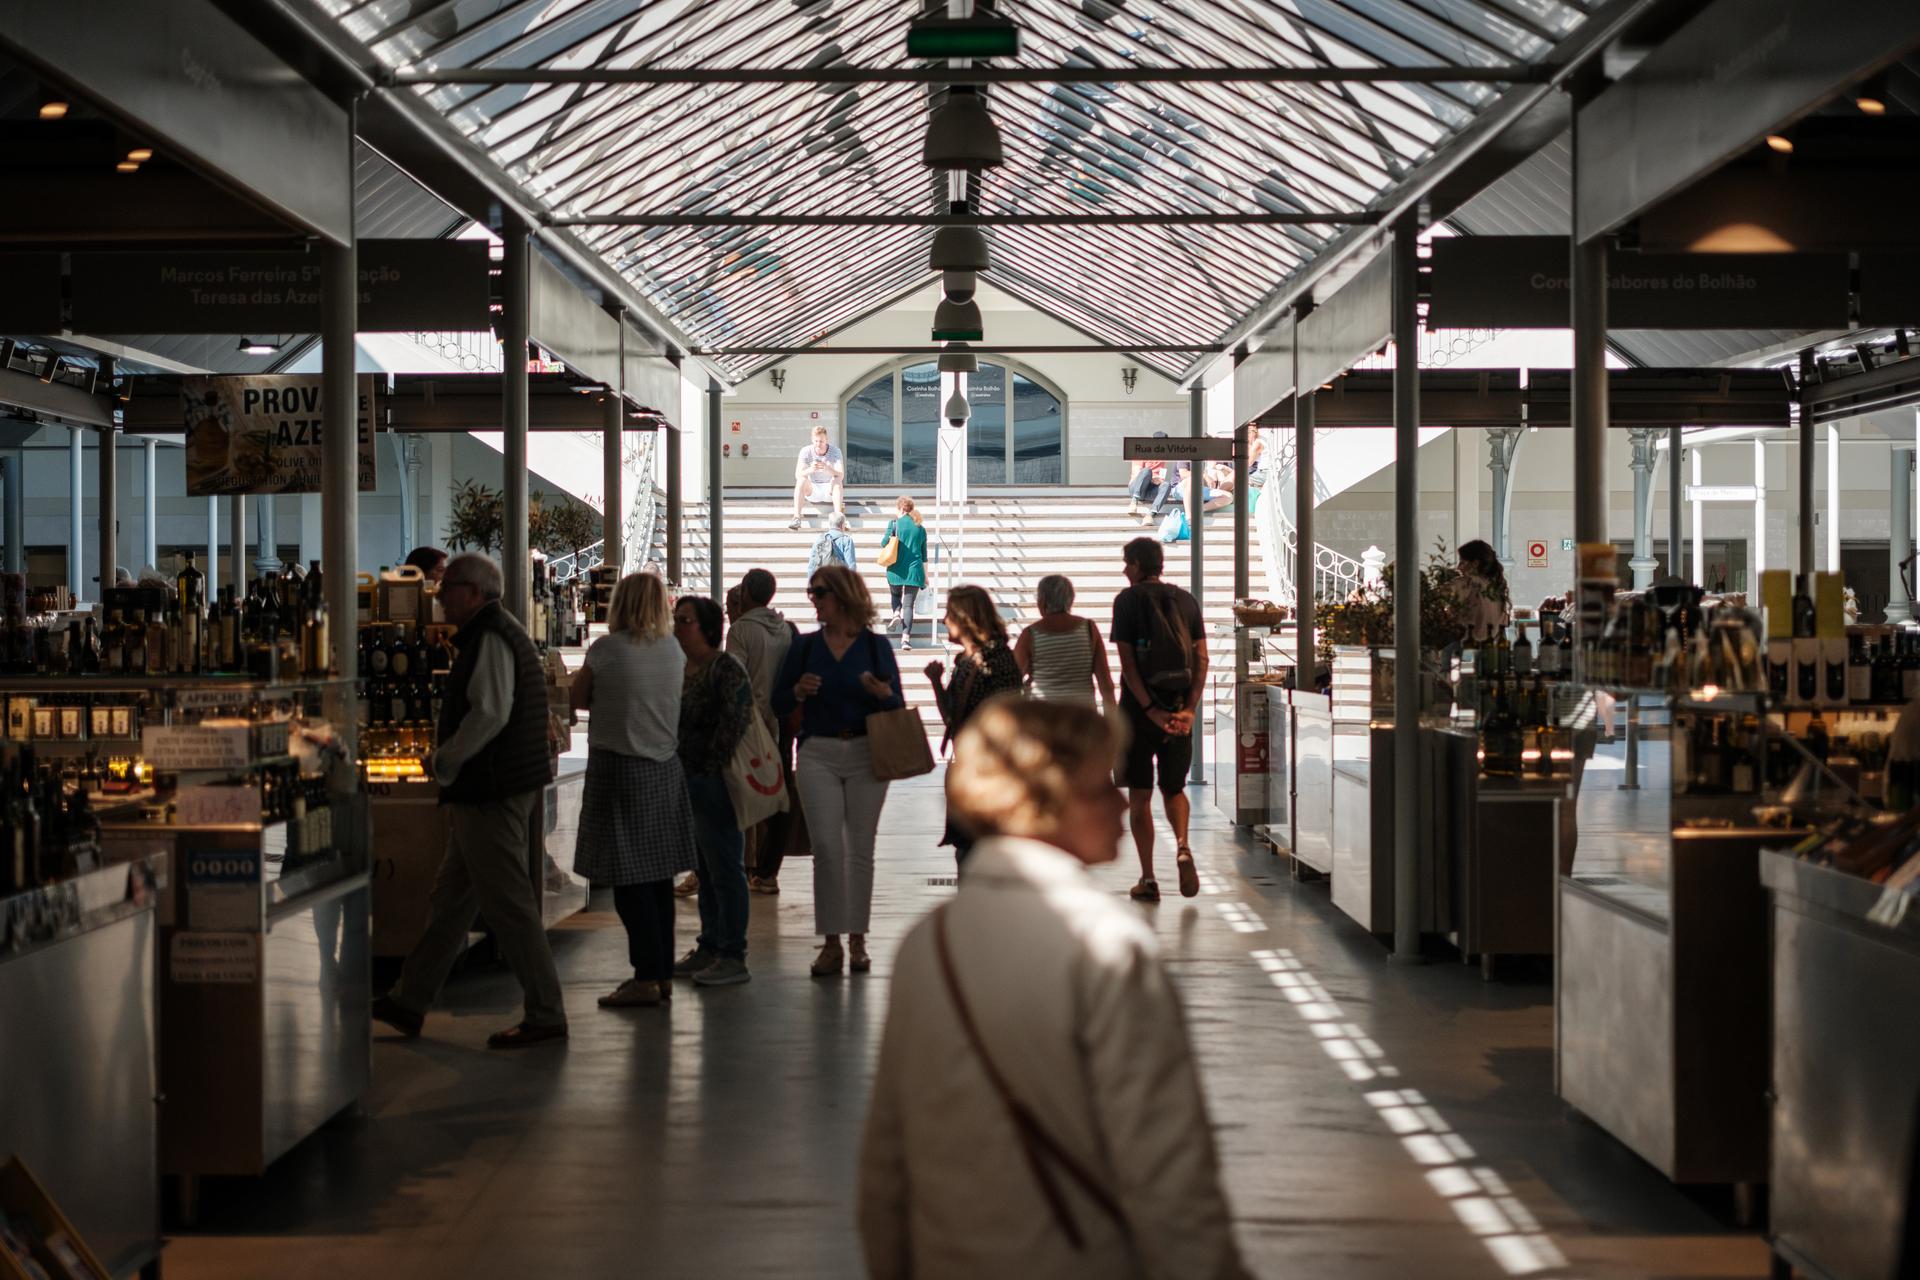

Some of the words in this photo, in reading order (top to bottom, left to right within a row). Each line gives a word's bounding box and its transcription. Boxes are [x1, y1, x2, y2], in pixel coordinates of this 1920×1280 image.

[161, 266, 225, 283] Marcos
[228, 266, 297, 282] Ferreira
[1530, 273, 1570, 289] Core
[1672, 272, 1694, 289] do
[1699, 272, 1757, 289] Bolhão
[191, 288, 247, 304] Teresa
[251, 288, 281, 304] das
[244, 386, 322, 415] PROV
[1135, 444, 1151, 453] Rua
[1154, 443, 1165, 453] da
[1167, 443, 1197, 453] Vitória
